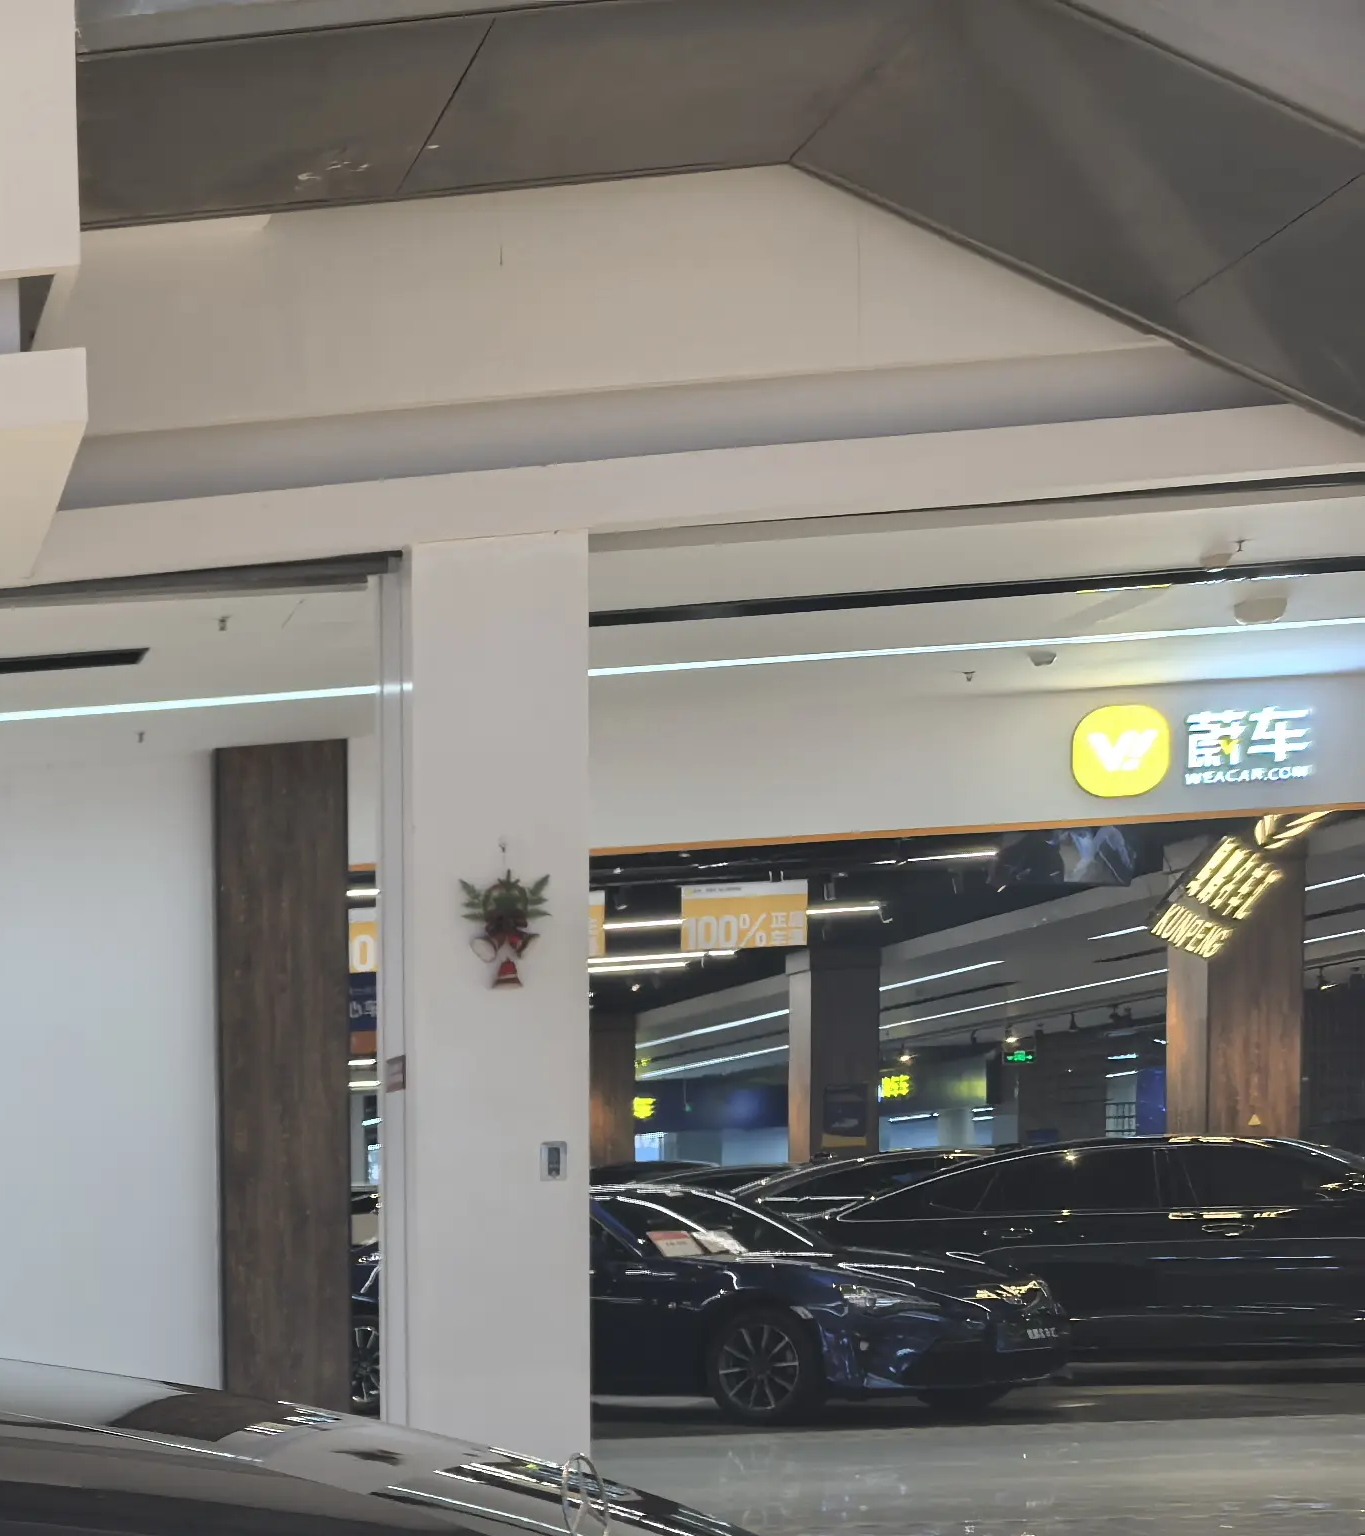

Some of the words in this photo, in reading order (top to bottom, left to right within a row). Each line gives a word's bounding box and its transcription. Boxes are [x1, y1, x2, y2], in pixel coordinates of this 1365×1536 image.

[1185, 705, 1311, 768] 蔚车
[1184, 764, 1313, 786] WEACAR.COM
[681, 911, 769, 950] 100%
[1150, 902, 1233, 958] KUNPENG
